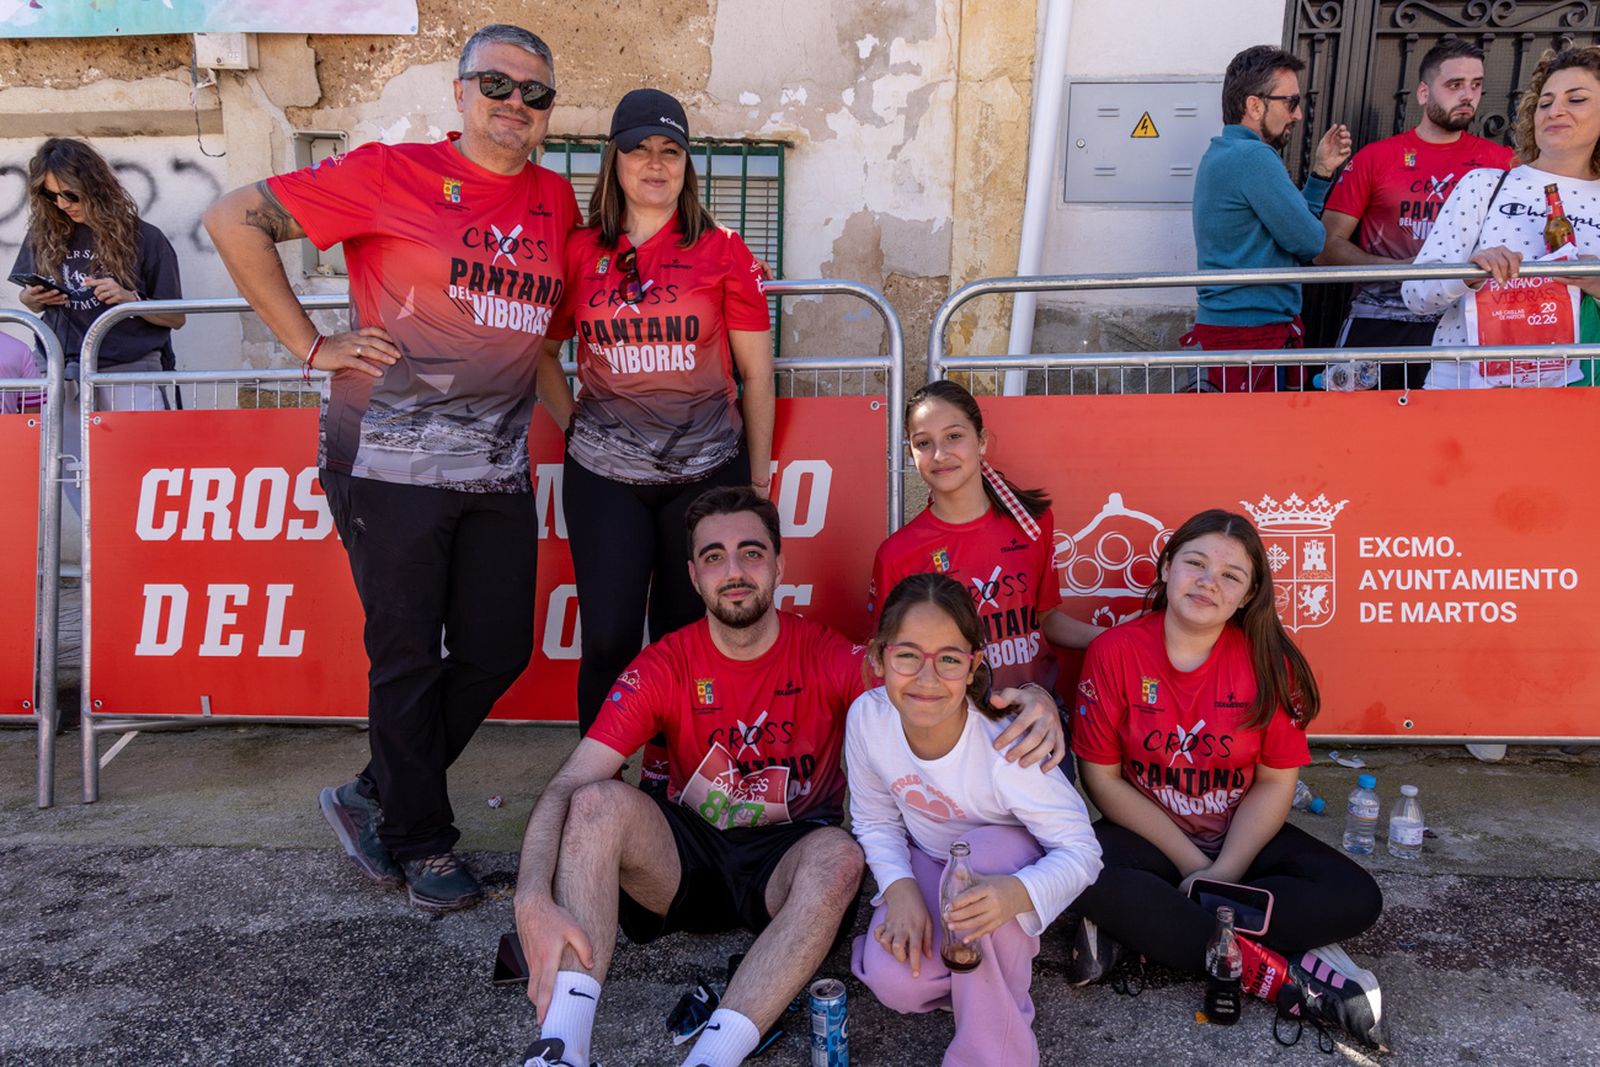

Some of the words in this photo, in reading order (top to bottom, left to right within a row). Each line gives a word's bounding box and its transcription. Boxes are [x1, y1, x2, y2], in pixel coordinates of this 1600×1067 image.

[1410, 180, 1458, 193] CRO
[1400, 201, 1445, 220] PANT
[462, 227, 549, 263] CROSS
[449, 284, 473, 301] DEL
[450, 257, 564, 306] PANTANO
[589, 284, 679, 308] CRSS
[1540, 302, 1557, 314] 20
[580, 315, 699, 346] PANTANO
[603, 338, 696, 374] VÍBORAS
[135, 467, 341, 541] CROS
[1359, 537, 1462, 558] EXCMO.
[968, 572, 1028, 604] ROSS
[1358, 568, 1578, 590] AYUNTAMIENTO
[135, 584, 305, 657] DEL
[1360, 602, 1392, 622] DE
[1400, 601, 1517, 623] MARTOS
[1143, 729, 1233, 758] CROSS
